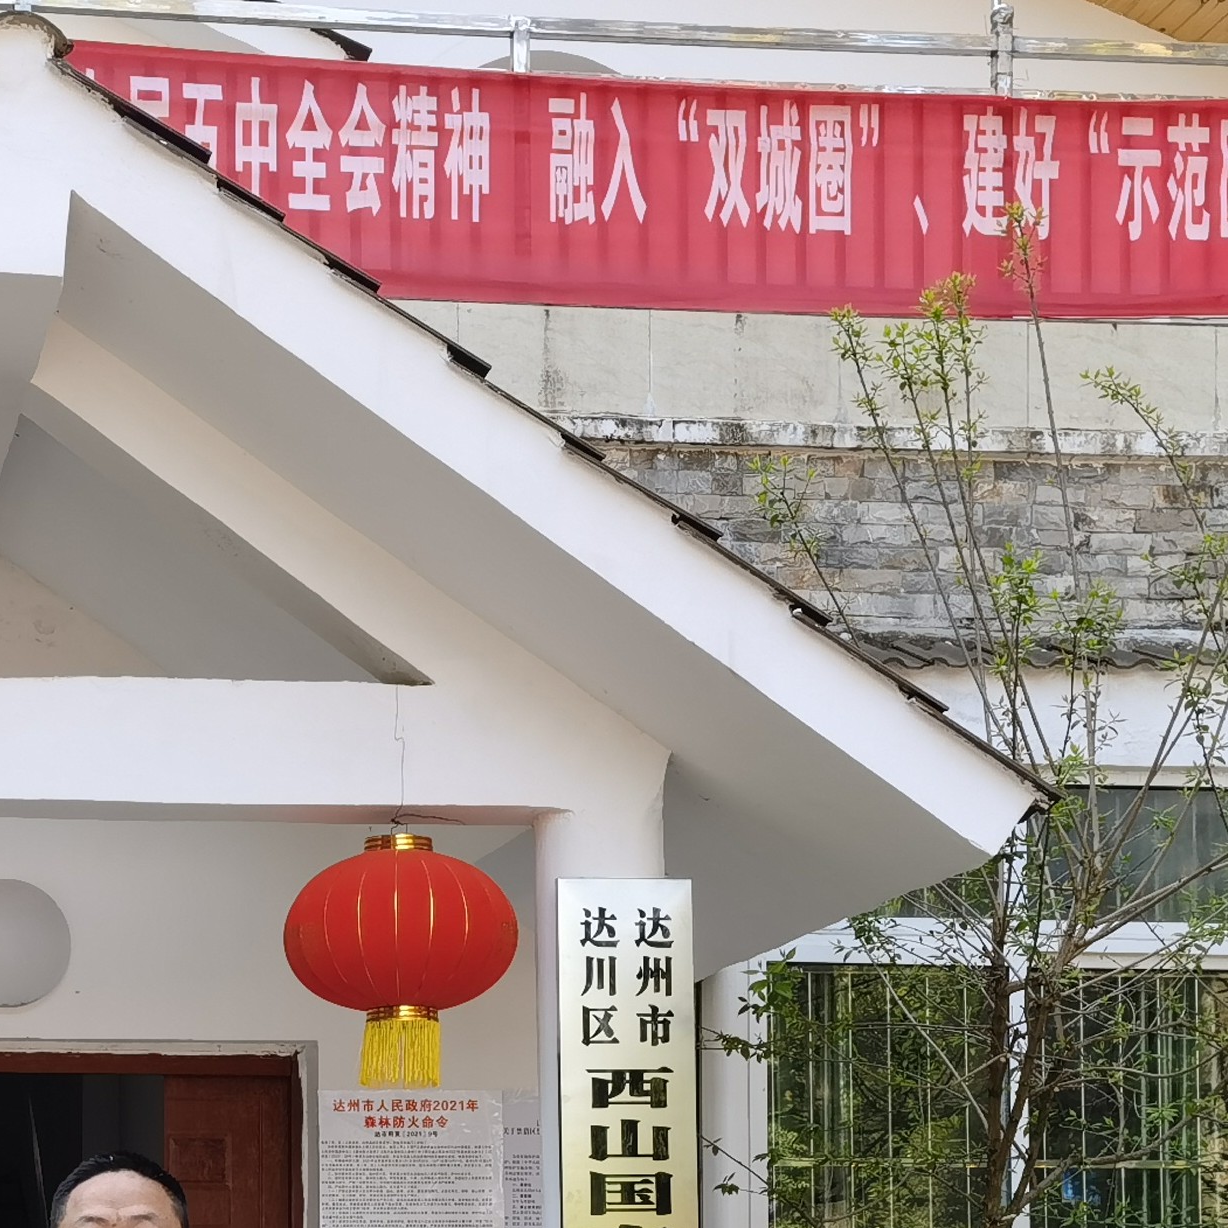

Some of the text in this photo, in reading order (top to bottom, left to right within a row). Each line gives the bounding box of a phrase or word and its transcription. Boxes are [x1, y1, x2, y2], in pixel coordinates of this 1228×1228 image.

[580, 908, 620, 1046] 达川区
[635, 907, 675, 1047] 达州市
[332, 1098, 480, 1113] 达州市人民政府2021年
[363, 1115, 449, 1129] 森林防火命令
